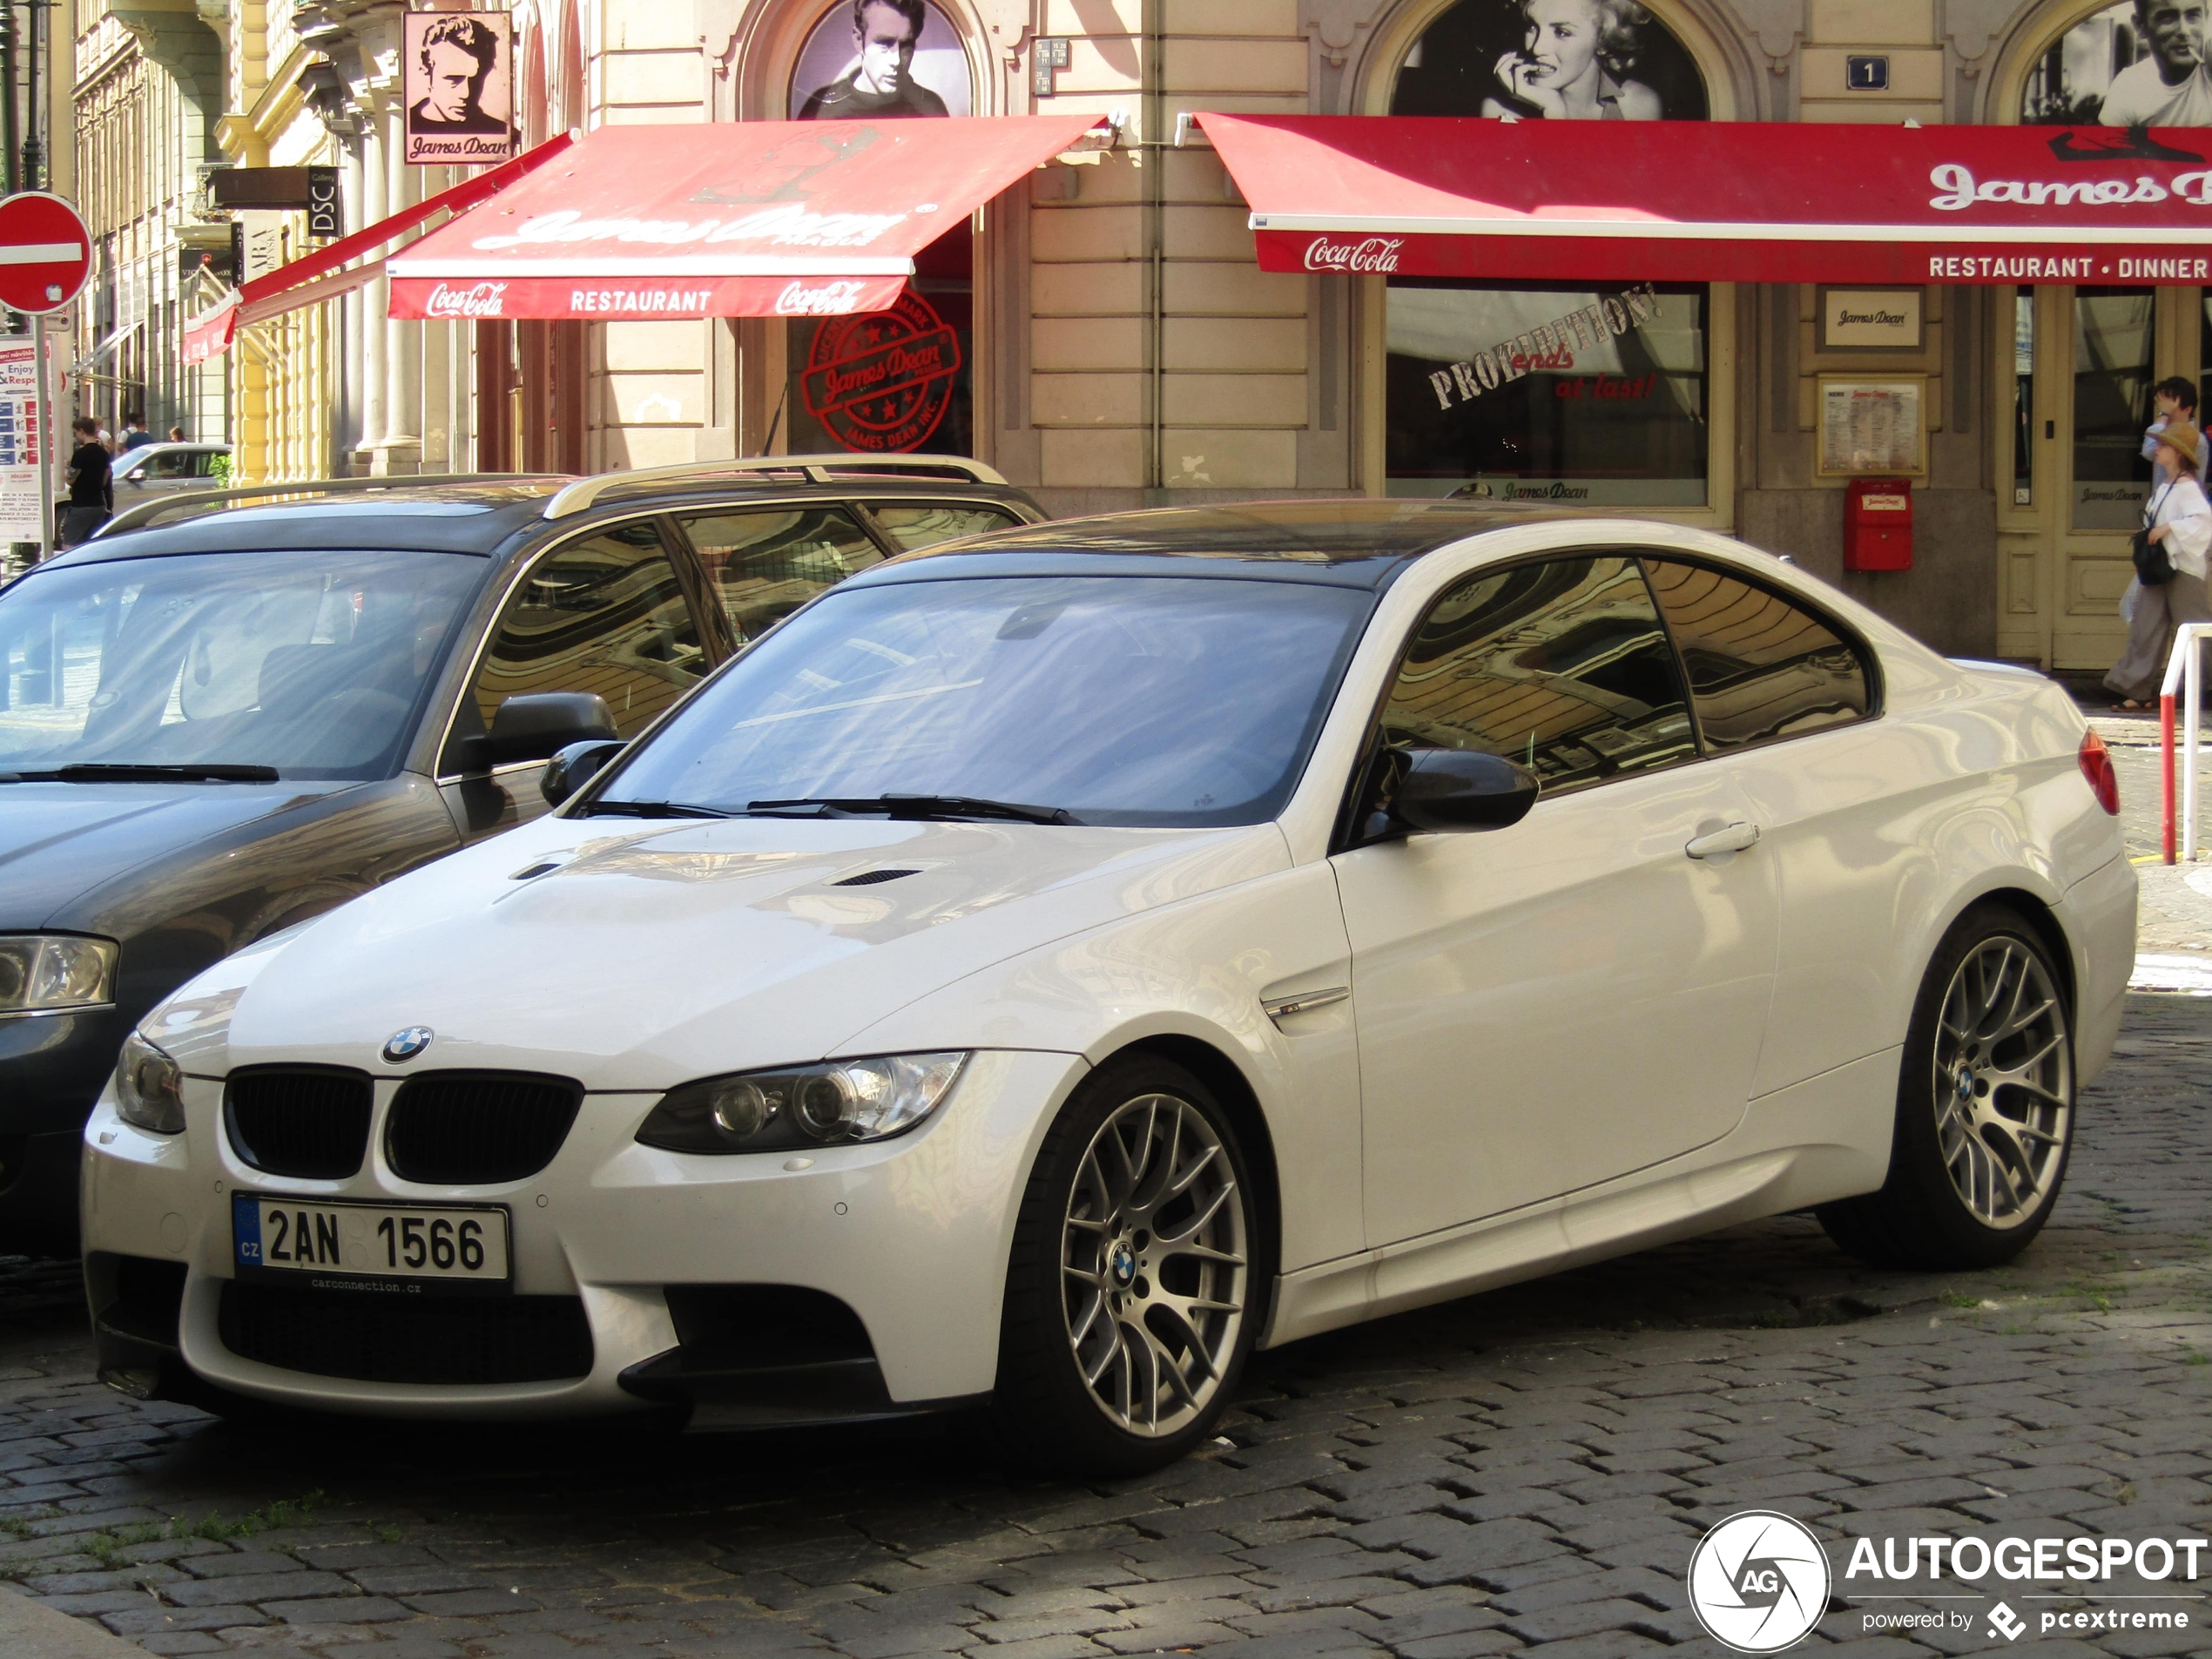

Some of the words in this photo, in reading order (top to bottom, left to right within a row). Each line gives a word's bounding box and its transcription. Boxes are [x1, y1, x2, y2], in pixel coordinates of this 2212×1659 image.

[1864, 63, 1873, 83] 1
[409, 137, 462, 158] James
[463, 137, 507, 154] Dean
[1929, 164, 2168, 211] James
[312, 186, 335, 230] DSC
[1304, 237, 1405, 272] Coca-Cola
[1930, 258, 2093, 278] RESTAURANT
[2119, 259, 2208, 279] DINNER
[427, 283, 509, 316] Coca-Cola
[570, 291, 711, 312] RESTAURANT
[775, 280, 867, 314] Coca-Cola
[1838, 310, 1874, 327] James
[1874, 310, 1905, 324] Dean
[1512, 343, 1574, 369] ends
[8, 365, 34, 375] Enjoy
[823, 360, 887, 404] James
[887, 344, 941, 376] Dean
[1554, 376, 1586, 400] at
[1591, 371, 1658, 400] last!
[846, 426, 885, 448] JAMES
[887, 423, 920, 448] DEAN
[919, 400, 939, 426] INC.
[1502, 482, 1548, 502] James
[1550, 482, 1588, 499] Dean
[2080, 488, 2114, 502] James
[2114, 489, 2142, 501] Dean
[241, 1242, 259, 1258] CZ
[268, 1210, 341, 1264] 2AN
[378, 1217, 484, 1270] 1566
[312, 1278, 421, 1293] carconnection.cz
